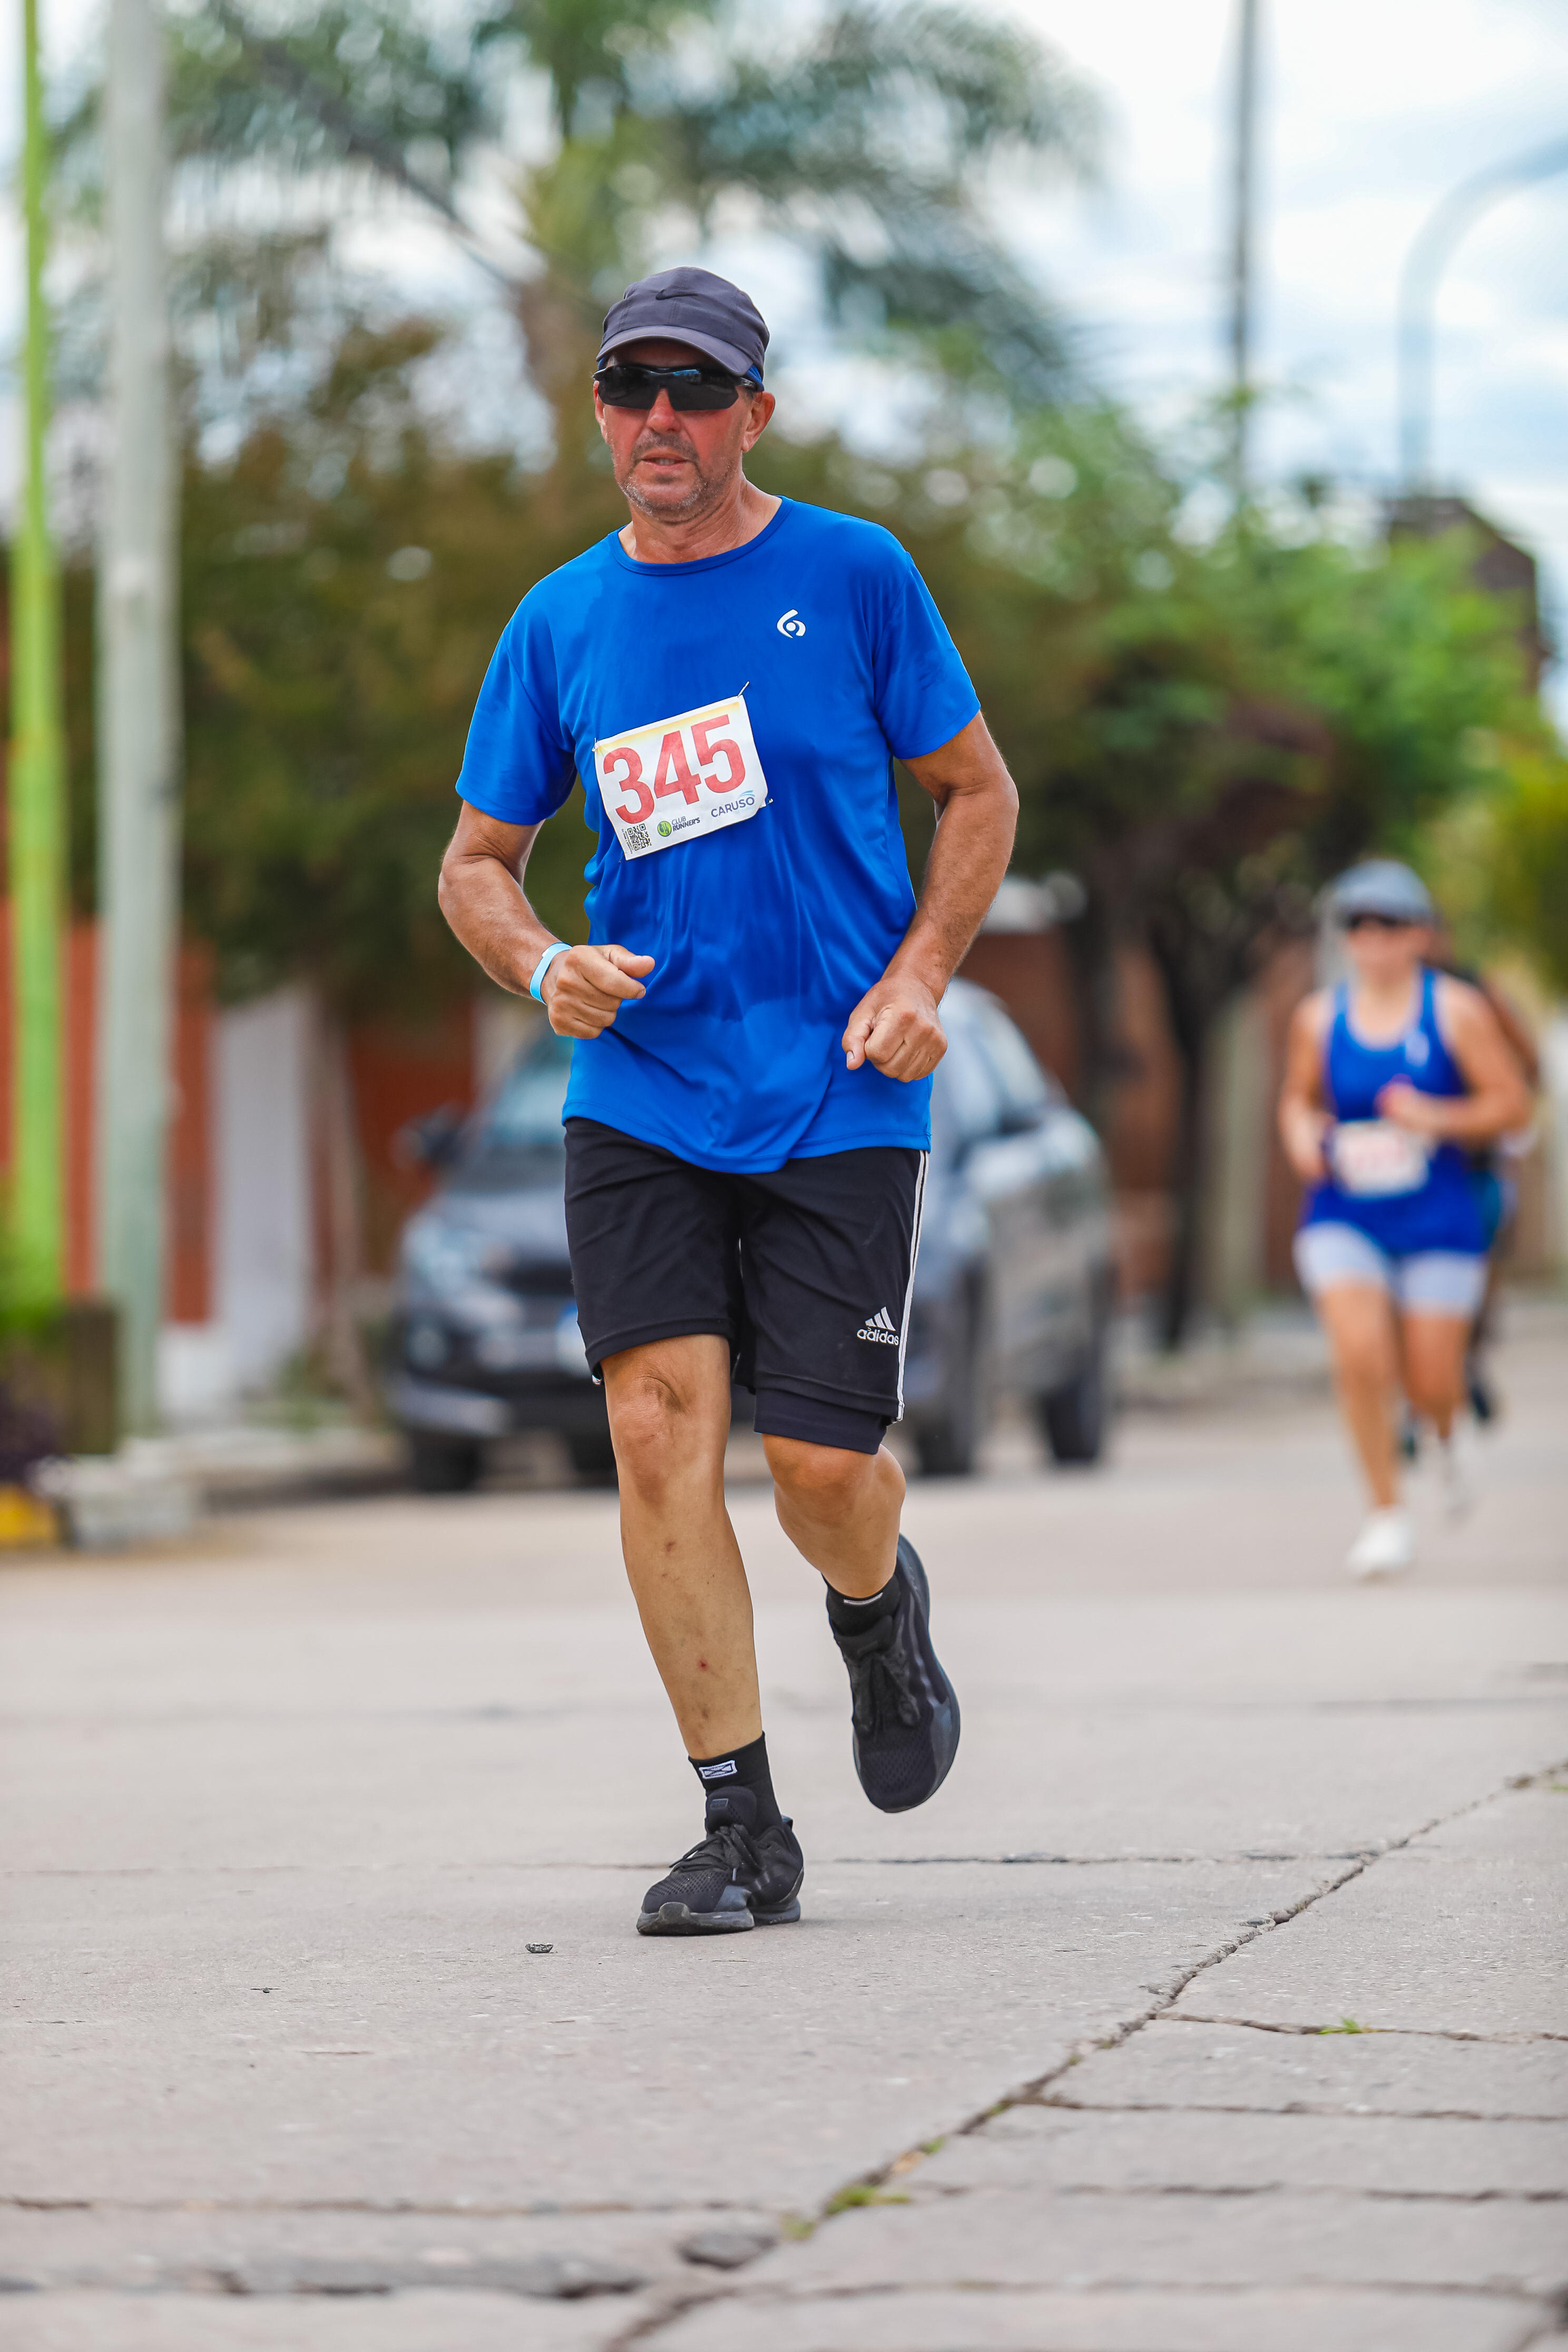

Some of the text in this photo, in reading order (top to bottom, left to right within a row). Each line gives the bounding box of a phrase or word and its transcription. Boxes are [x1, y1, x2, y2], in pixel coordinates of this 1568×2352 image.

[603, 714, 746, 824] 345
[711, 796, 754, 817] CARUSO
[672, 816, 686, 825] CLUB
[672, 817, 700, 831] RUNNER'S
[857, 1328, 899, 1346] adidas
